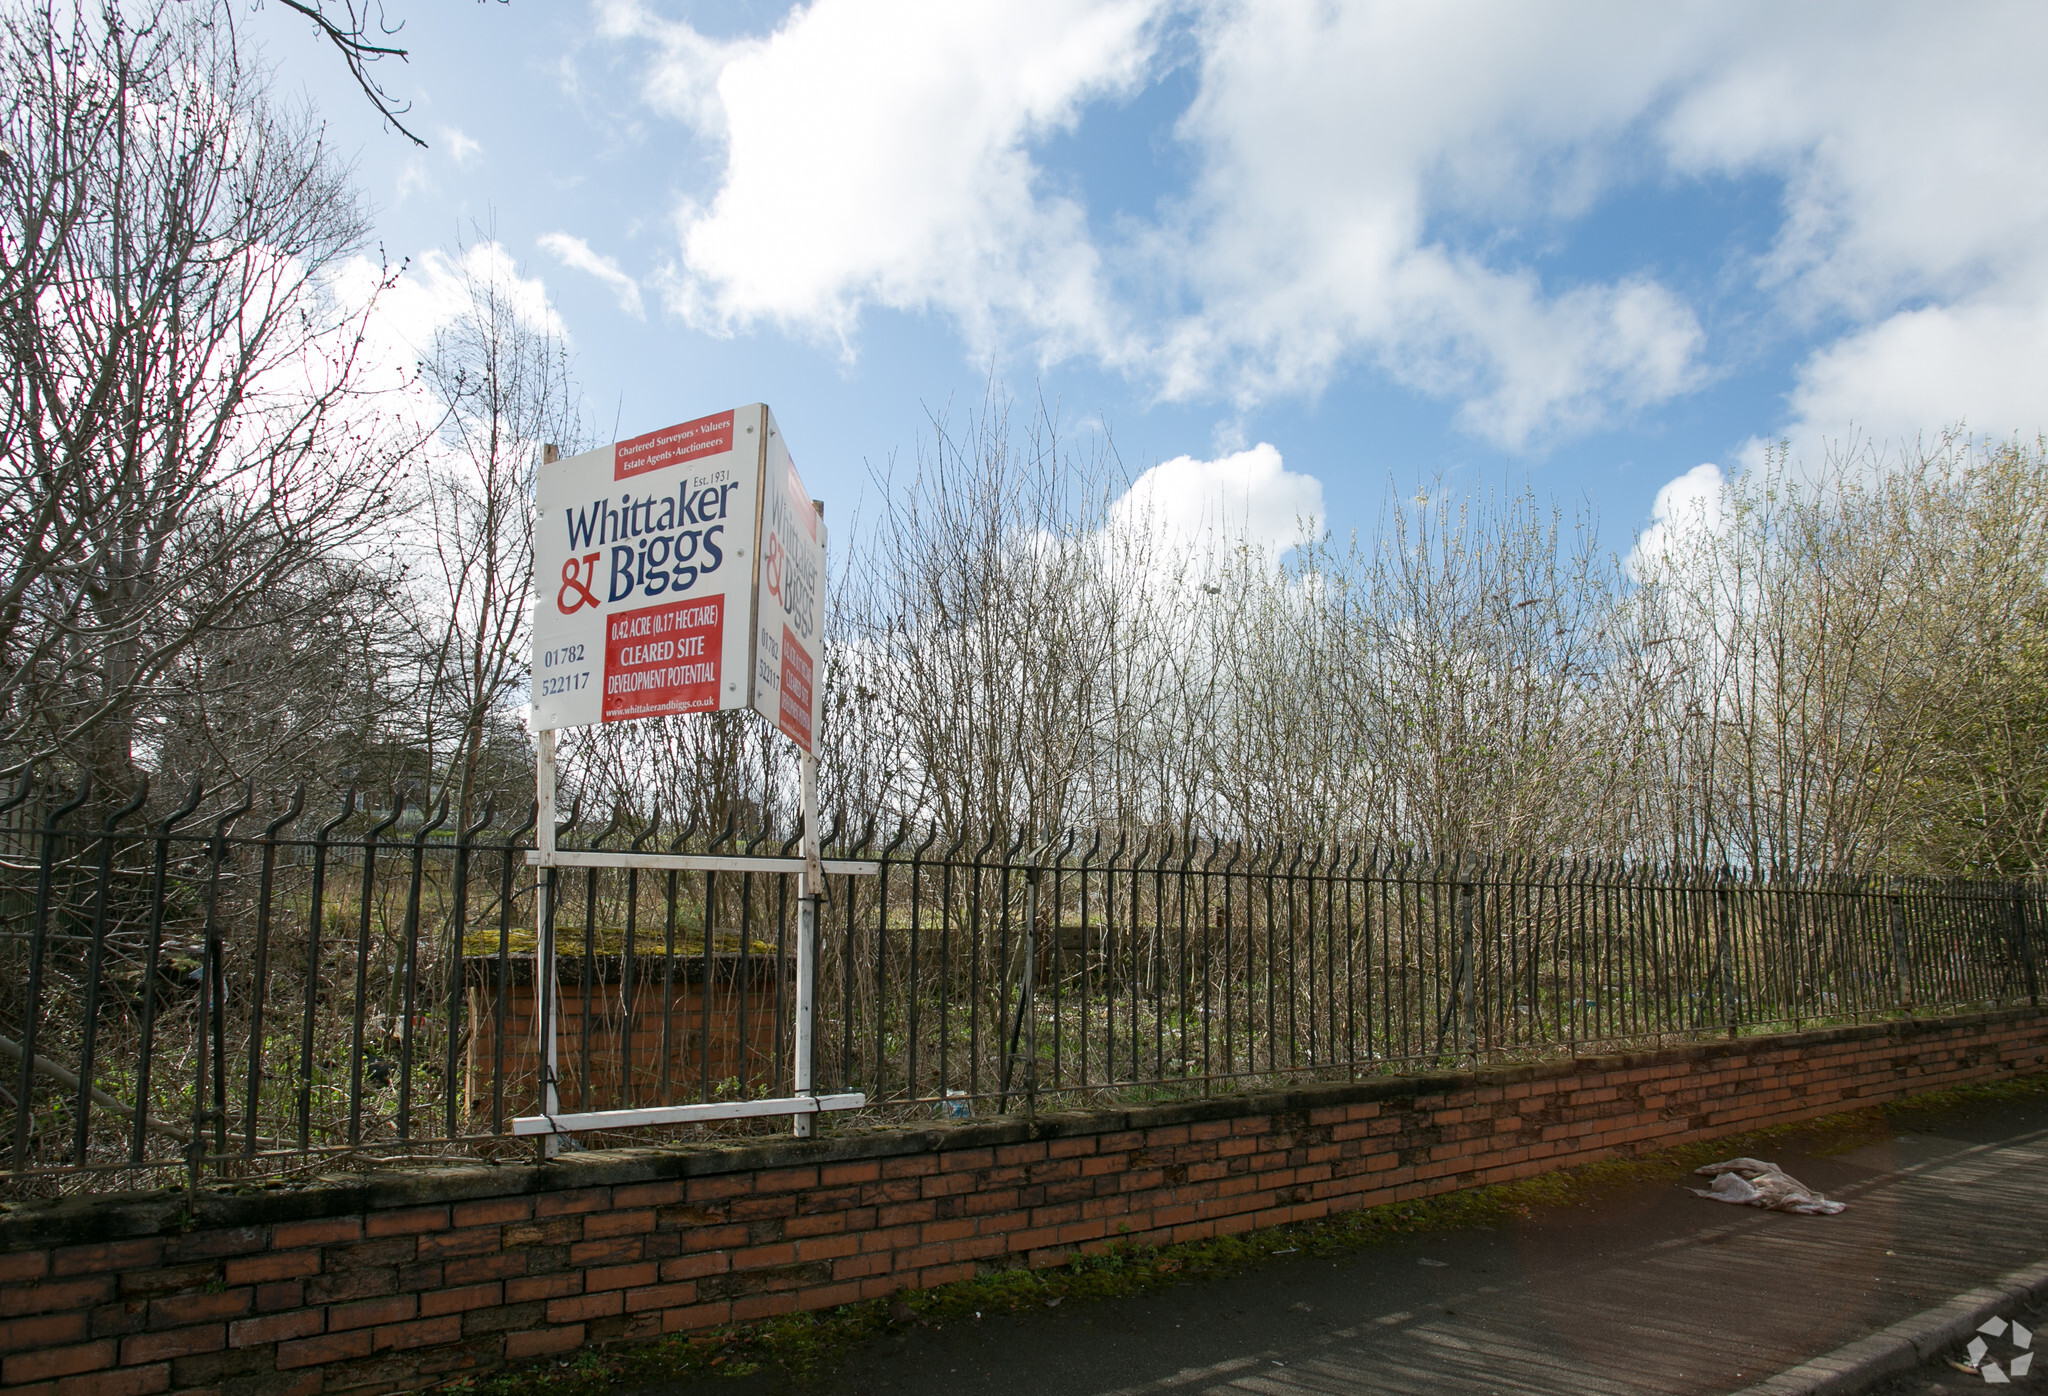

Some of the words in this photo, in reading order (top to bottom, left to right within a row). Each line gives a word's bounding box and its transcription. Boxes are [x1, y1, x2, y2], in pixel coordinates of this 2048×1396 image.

[618, 441, 655, 457] Chartered
[656, 429, 694, 446] Surveyors
[700, 419, 731, 434] Valuers
[623, 458, 645, 471] Estate
[646, 450, 672, 466] Agents
[675, 437, 724, 456] Auctioneers
[566, 479, 740, 551] Whittaker
[772, 474, 818, 595] Whittaker
[557, 551, 601, 616] &
[607, 524, 725, 603] Biggs
[766, 531, 783, 607] &
[784, 554, 815, 640] Biggs
[611, 619, 629, 641] 0.42
[629, 616, 652, 638] ACRE
[653, 612, 675, 637] (0.17
[675, 604, 719, 630] HECTARE)
[544, 643, 585, 668] 01782
[620, 640, 675, 667] CLEARED
[677, 635, 705, 659] SITE
[761, 627, 779, 661] 01782
[542, 672, 591, 697] 522117
[607, 668, 667, 695] DEVELOPMENT
[667, 661, 716, 688] POTENTIAL
[758, 658, 780, 692] 522117
[605, 696, 715, 717] www.whittakerandbiggs.co.uk
